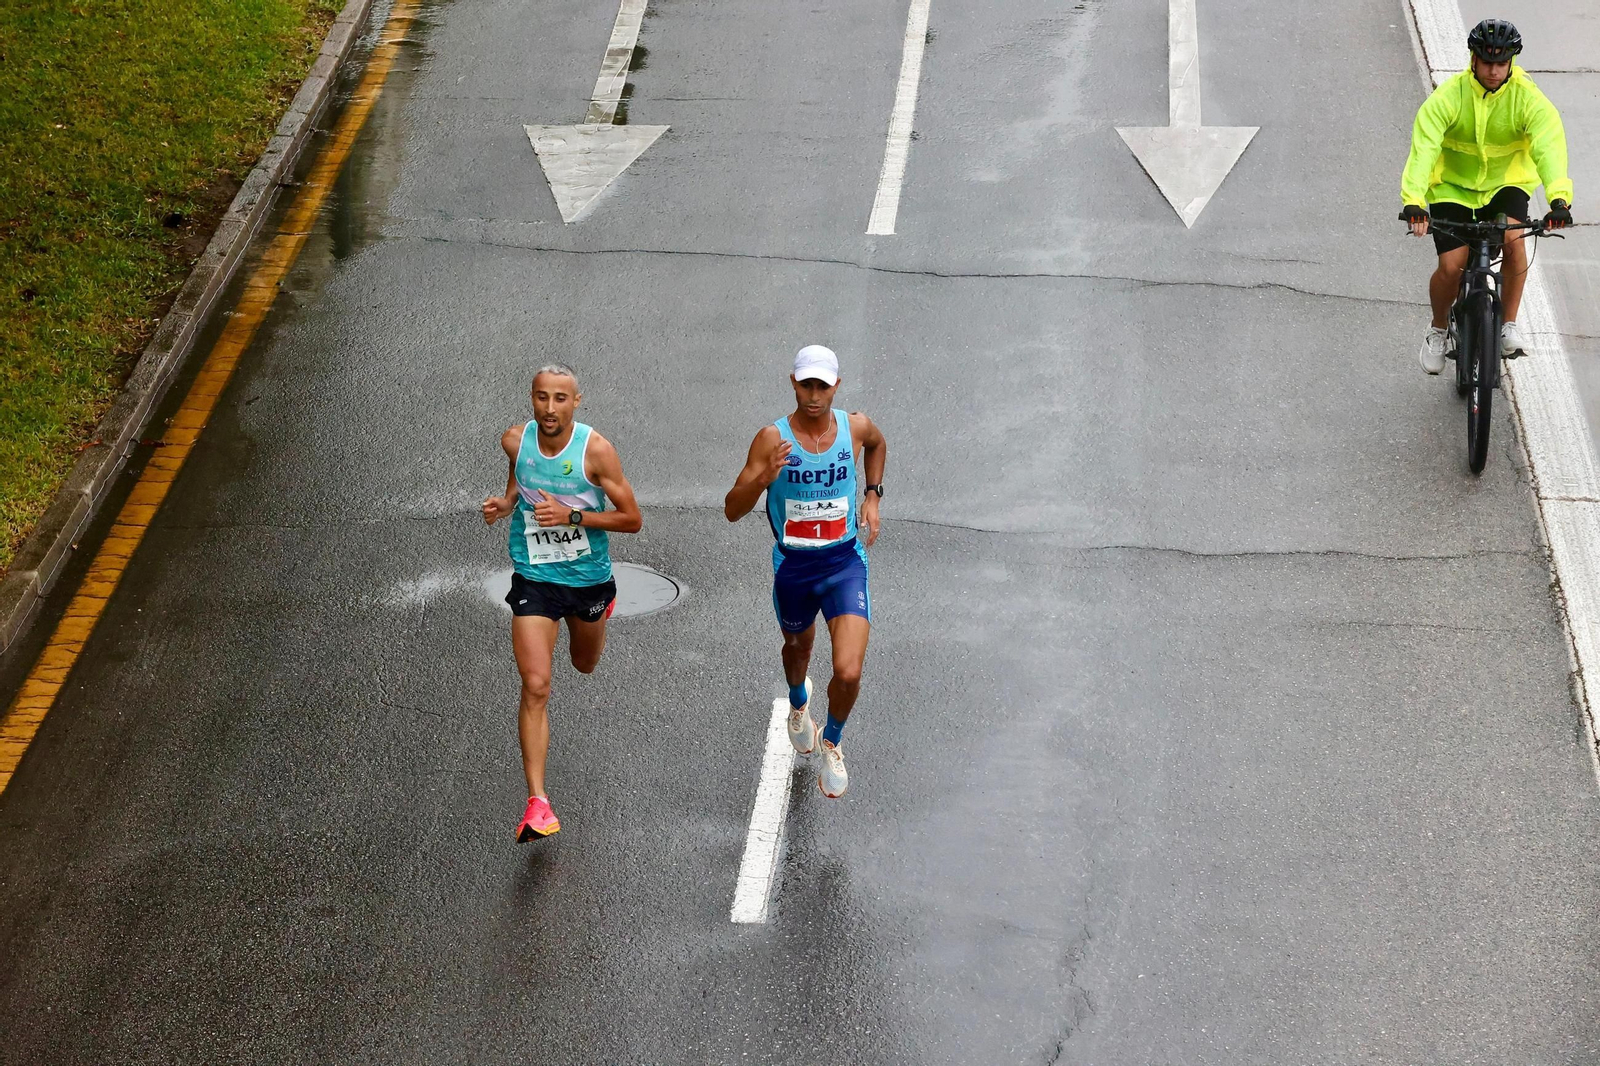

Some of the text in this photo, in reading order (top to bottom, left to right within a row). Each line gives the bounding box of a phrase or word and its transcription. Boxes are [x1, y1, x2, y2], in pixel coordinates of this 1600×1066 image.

[787, 463, 847, 487] nerja
[795, 488, 840, 499] ATLETISMO
[531, 528, 582, 545] 11344
[812, 523, 821, 538] 1
